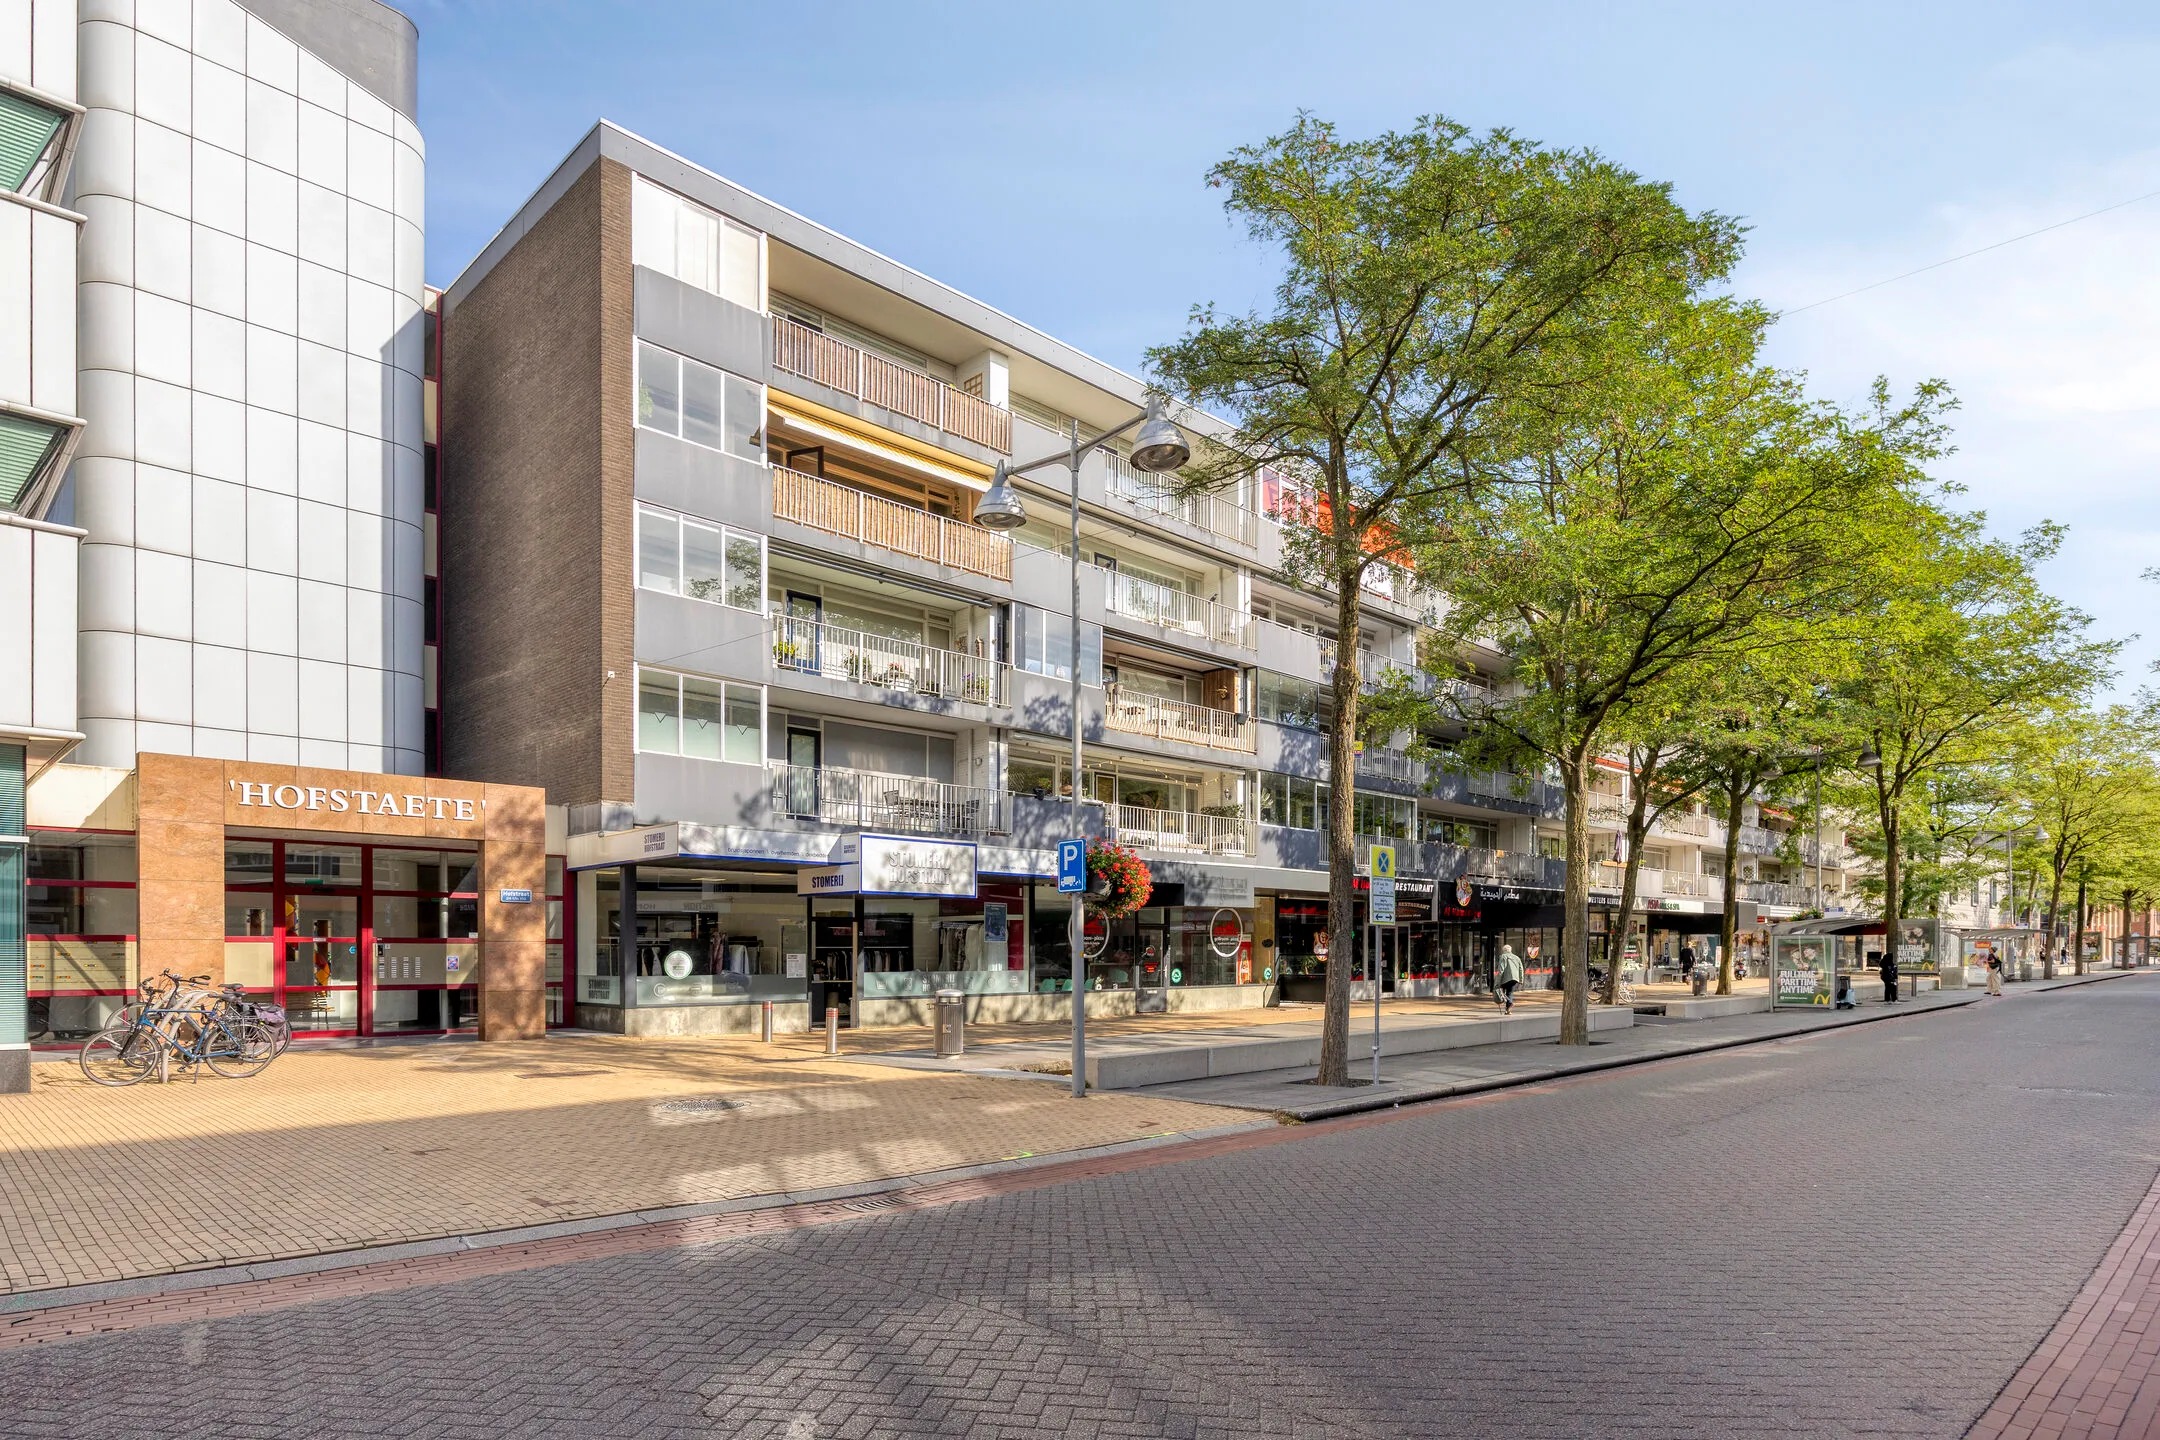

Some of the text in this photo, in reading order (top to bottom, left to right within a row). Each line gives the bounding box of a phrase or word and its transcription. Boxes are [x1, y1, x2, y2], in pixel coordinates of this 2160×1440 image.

[889, 850, 952, 870] STOMERIJ
[1064, 845, 1078, 871] P
[812, 875, 844, 888] STOMERIJ
[889, 867, 952, 886] HOFSTRAAT
[1394, 882, 1434, 893] RESTAURANT
[1780, 970, 1816, 978] FULLTIME
[1780, 978, 1818, 986] PARTTIME
[1780, 986, 1815, 994] ANYTIME
